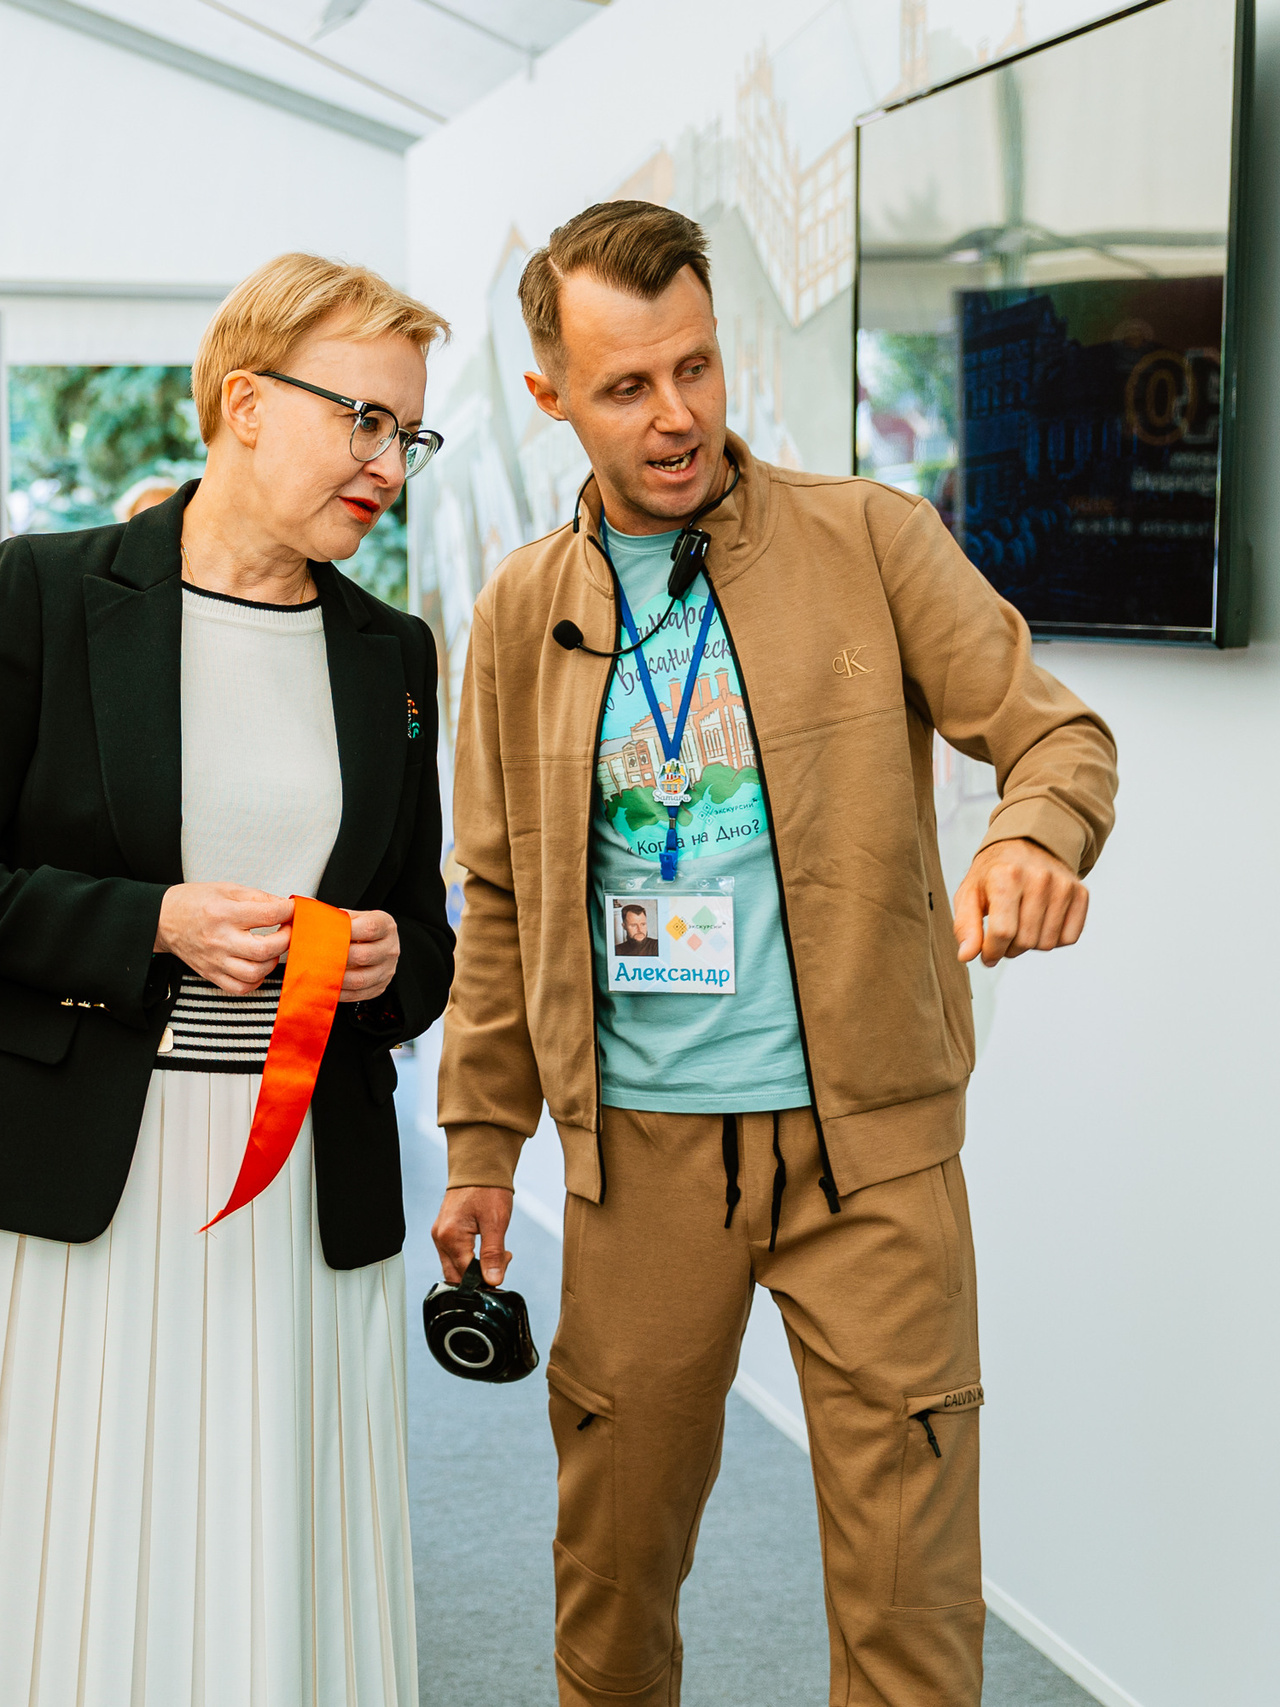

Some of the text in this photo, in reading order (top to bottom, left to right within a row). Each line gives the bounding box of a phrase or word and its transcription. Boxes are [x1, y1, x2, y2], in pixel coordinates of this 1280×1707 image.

[653, 790, 689, 801] Samara
[637, 838, 685, 856] Кога
[691, 831, 709, 846] на
[716, 819, 760, 843] Дно?
[615, 962, 730, 987] Александр
[944, 1388, 977, 1408] CALVIN
